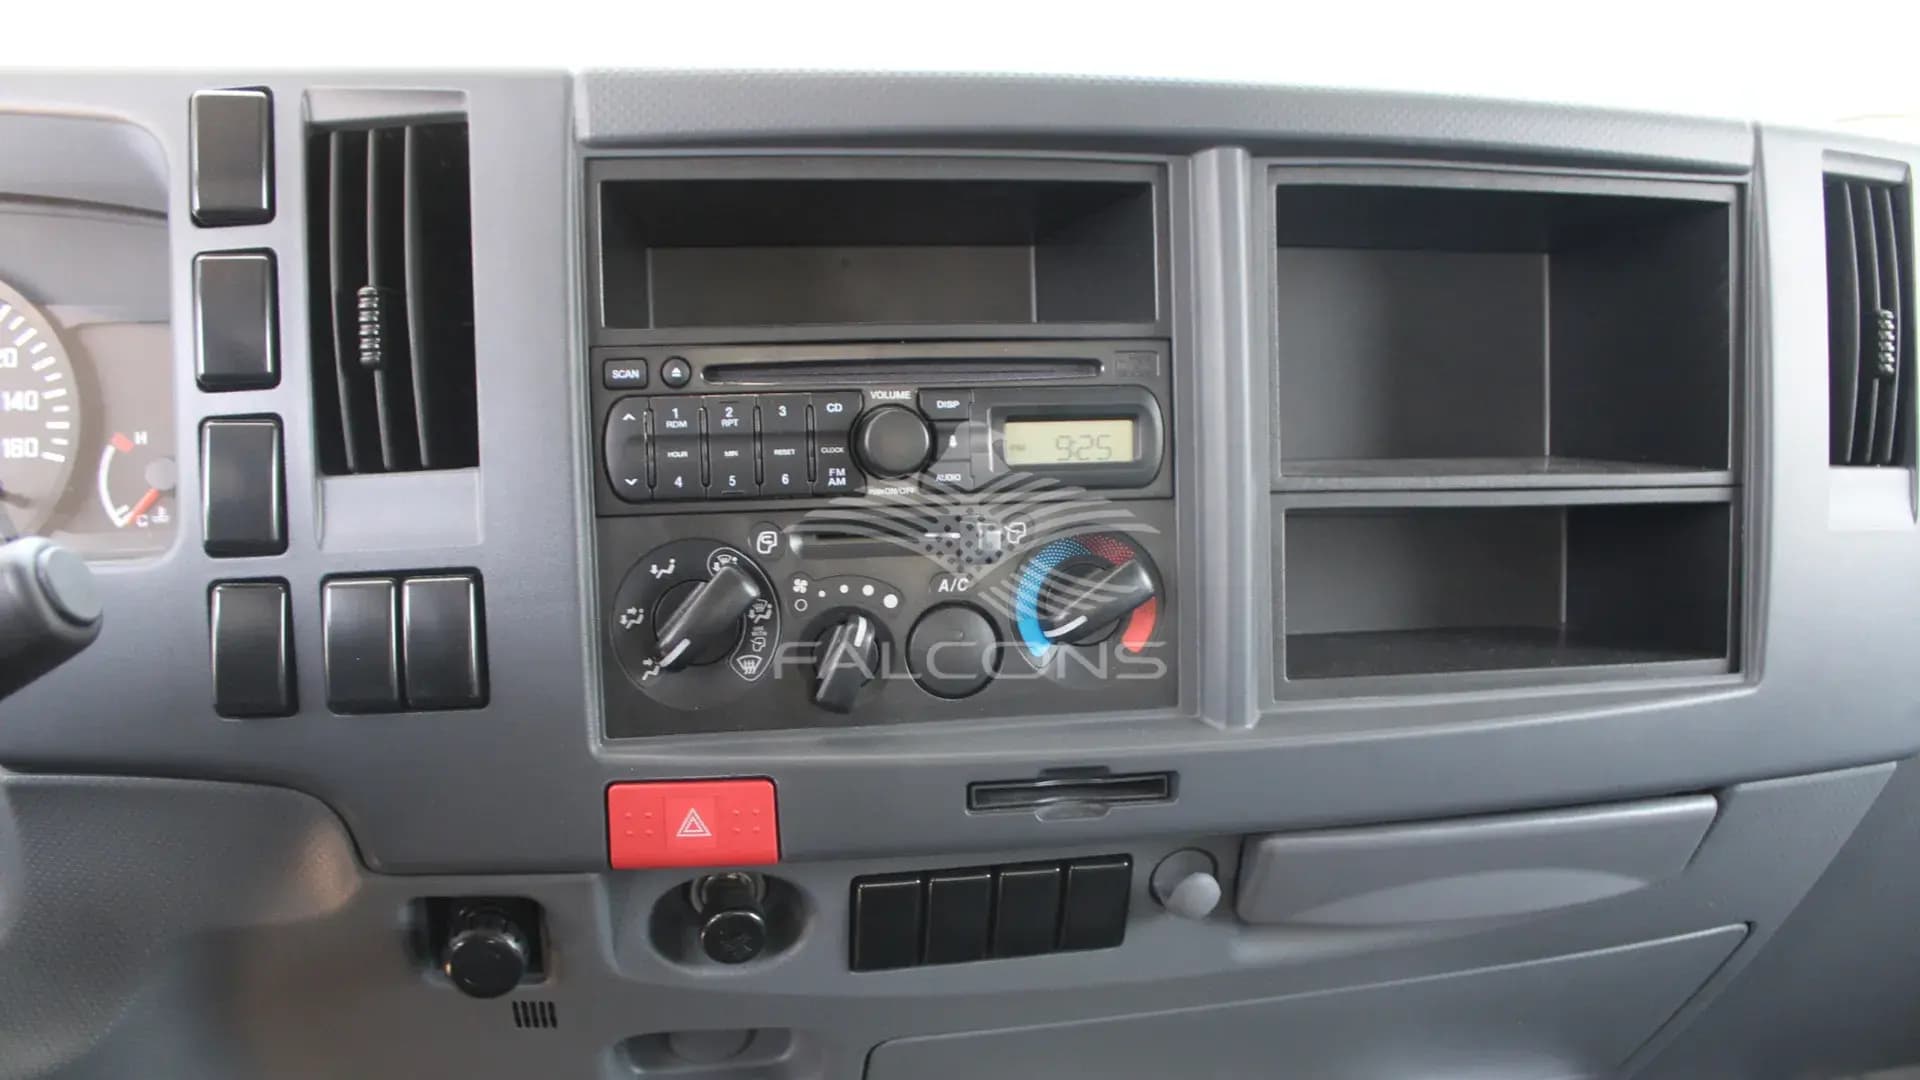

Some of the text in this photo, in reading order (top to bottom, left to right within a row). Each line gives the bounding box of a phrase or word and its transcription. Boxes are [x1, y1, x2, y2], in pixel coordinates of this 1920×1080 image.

[612, 369, 640, 379] SCAN
[3, 390, 39, 411] 140
[870, 390, 912, 400] VOLUME
[826, 403, 843, 413] CD
[936, 400, 960, 409] DISP
[671, 408, 679, 419] 1
[725, 406, 734, 418] 2
[778, 405, 787, 417] 3
[665, 420, 688, 428] RDM
[721, 419, 739, 427] RPT
[134, 431, 147, 445] H
[3, 438, 39, 458] 160
[1055, 434, 1112, 461] 9:25
[828, 468, 846, 477] FM
[936, 473, 962, 481] AUDIO
[674, 476, 683, 488] 4
[728, 475, 737, 487] 5
[781, 473, 790, 485] 6
[827, 478, 846, 486] AM
[135, 515, 148, 527] C
[937, 577, 971, 592] A/C
